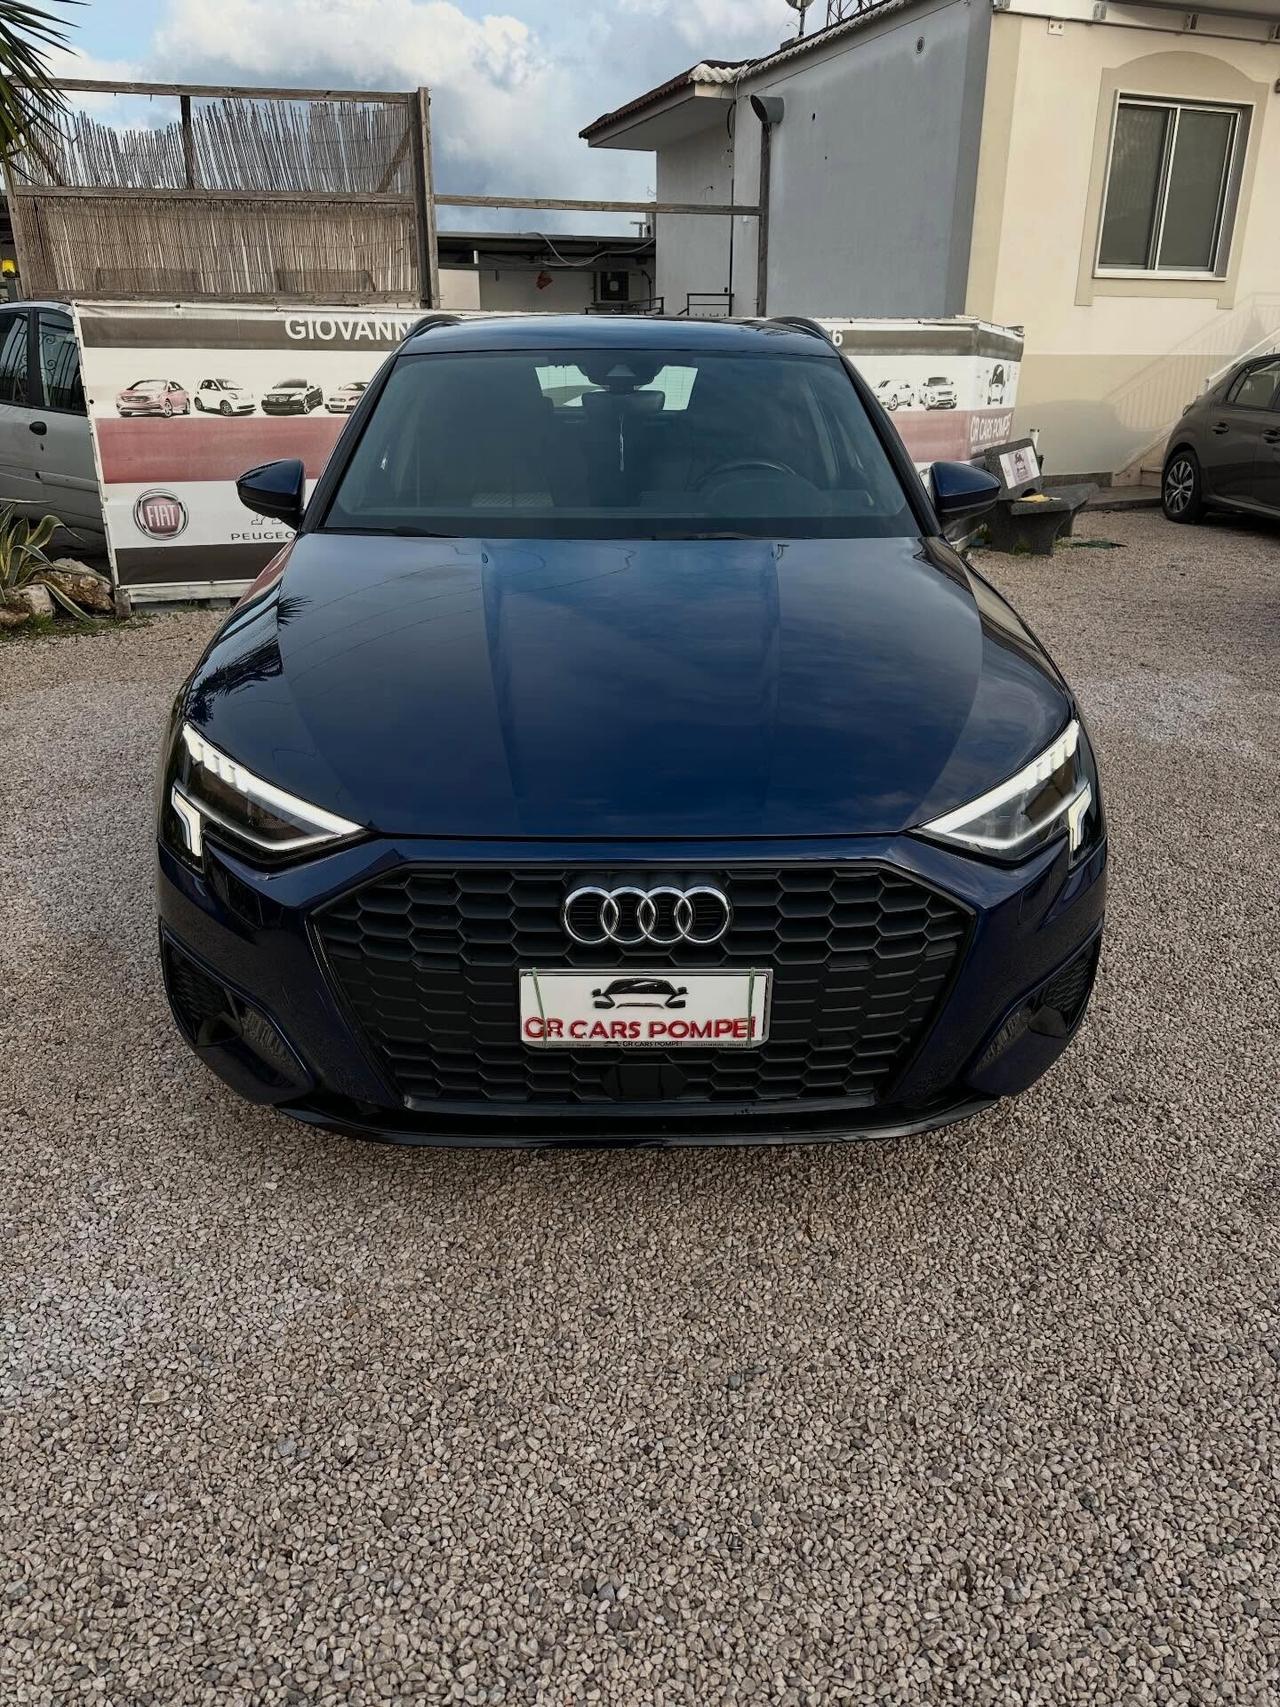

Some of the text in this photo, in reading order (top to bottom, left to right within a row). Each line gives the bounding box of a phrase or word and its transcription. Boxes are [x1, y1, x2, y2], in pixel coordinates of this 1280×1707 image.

[146, 504, 176, 526] FIAT
[524, 1016, 756, 1039] GR CARS POMPEI
